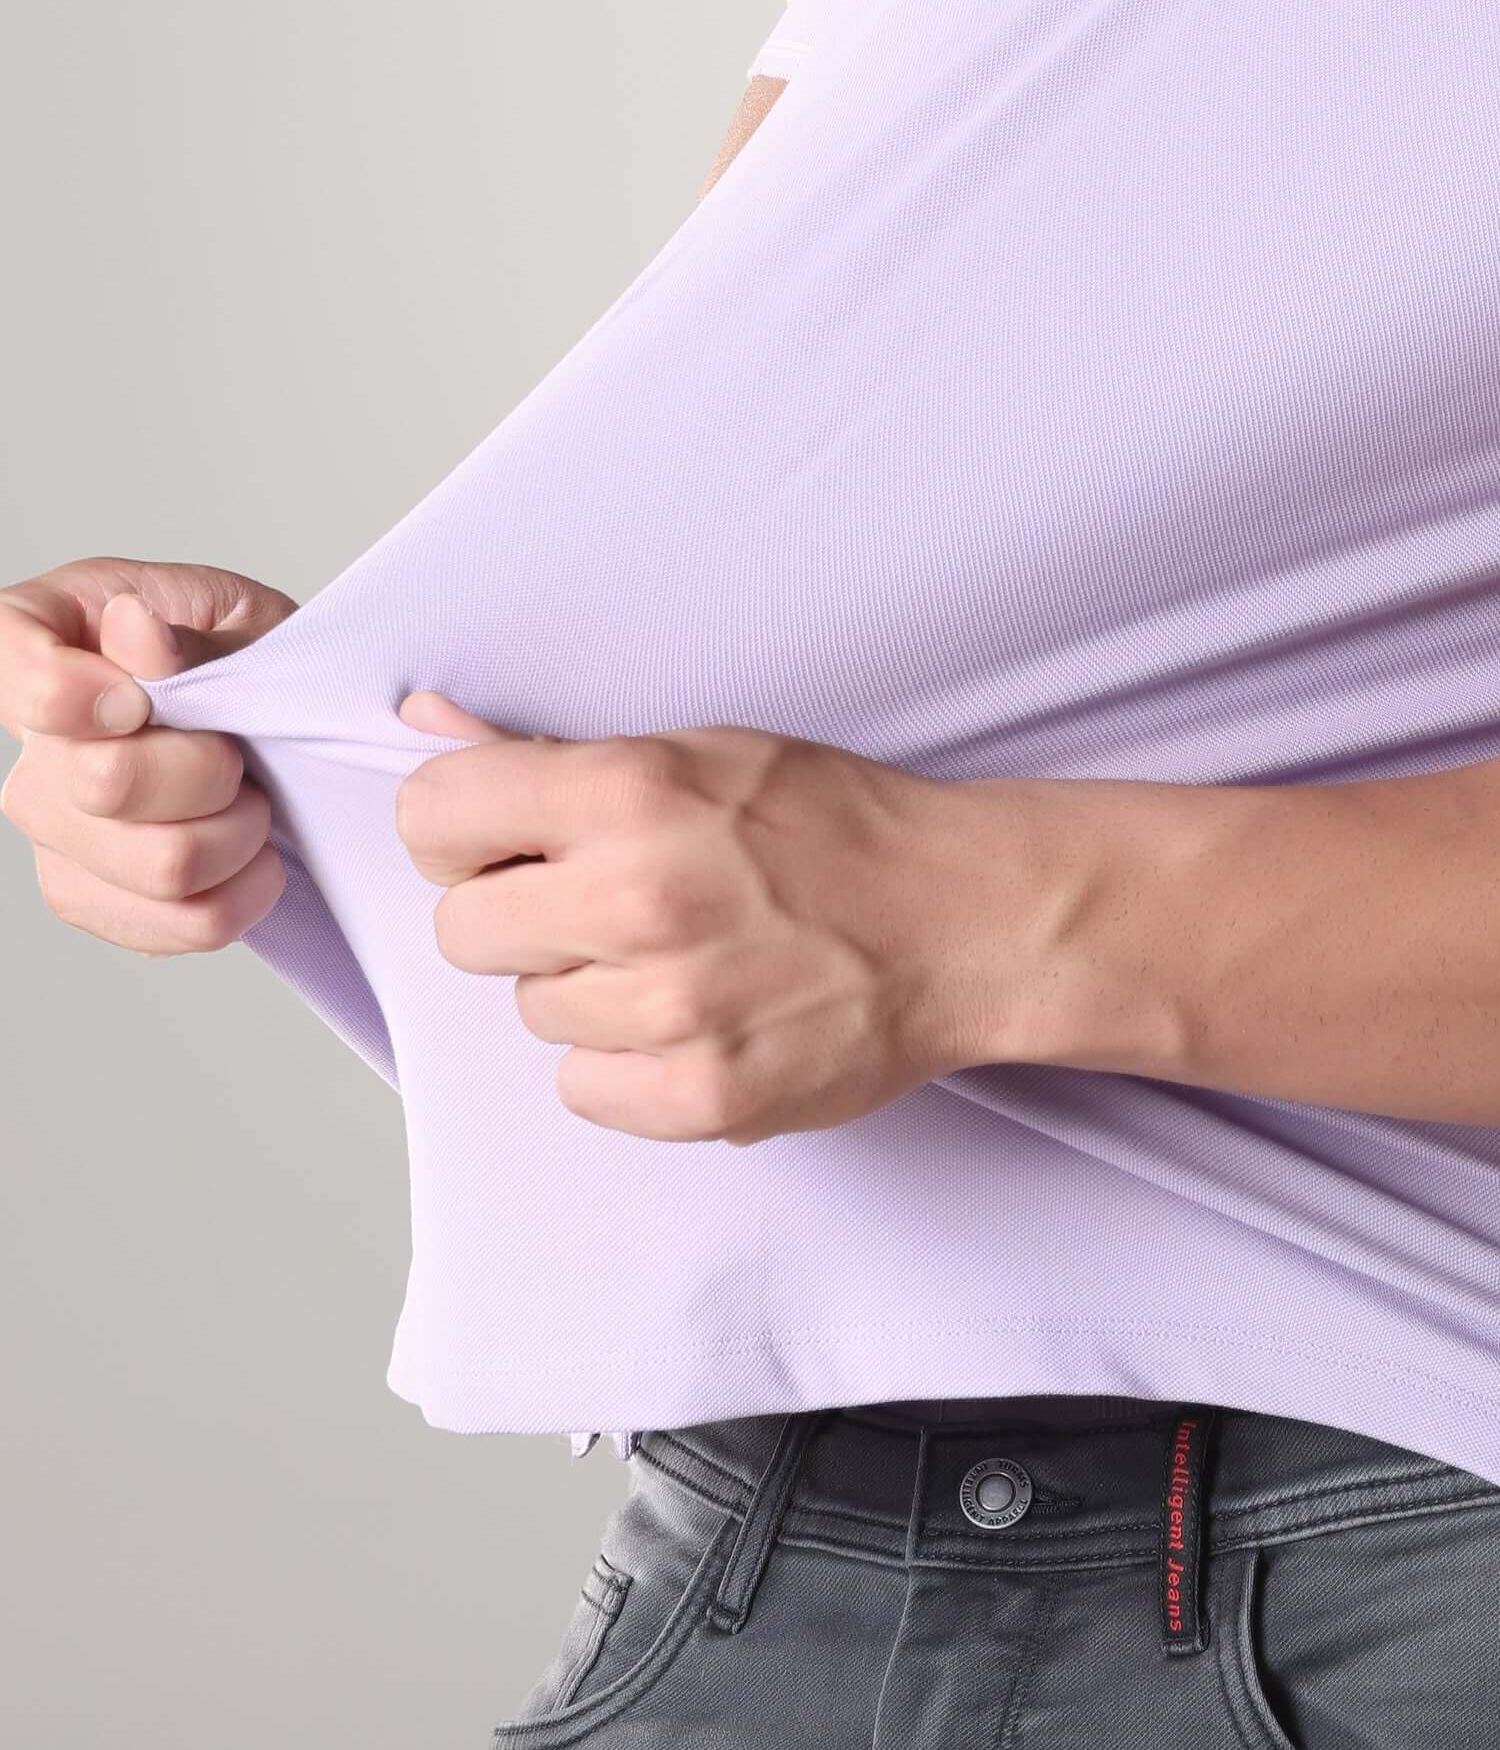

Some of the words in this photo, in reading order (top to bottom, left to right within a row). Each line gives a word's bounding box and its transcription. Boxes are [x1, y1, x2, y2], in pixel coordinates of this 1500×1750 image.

[988, 1498, 1028, 1526] APPAREL
[1168, 1420, 1197, 1550] Intelligent
[1168, 1559, 1185, 1632] Jeans
